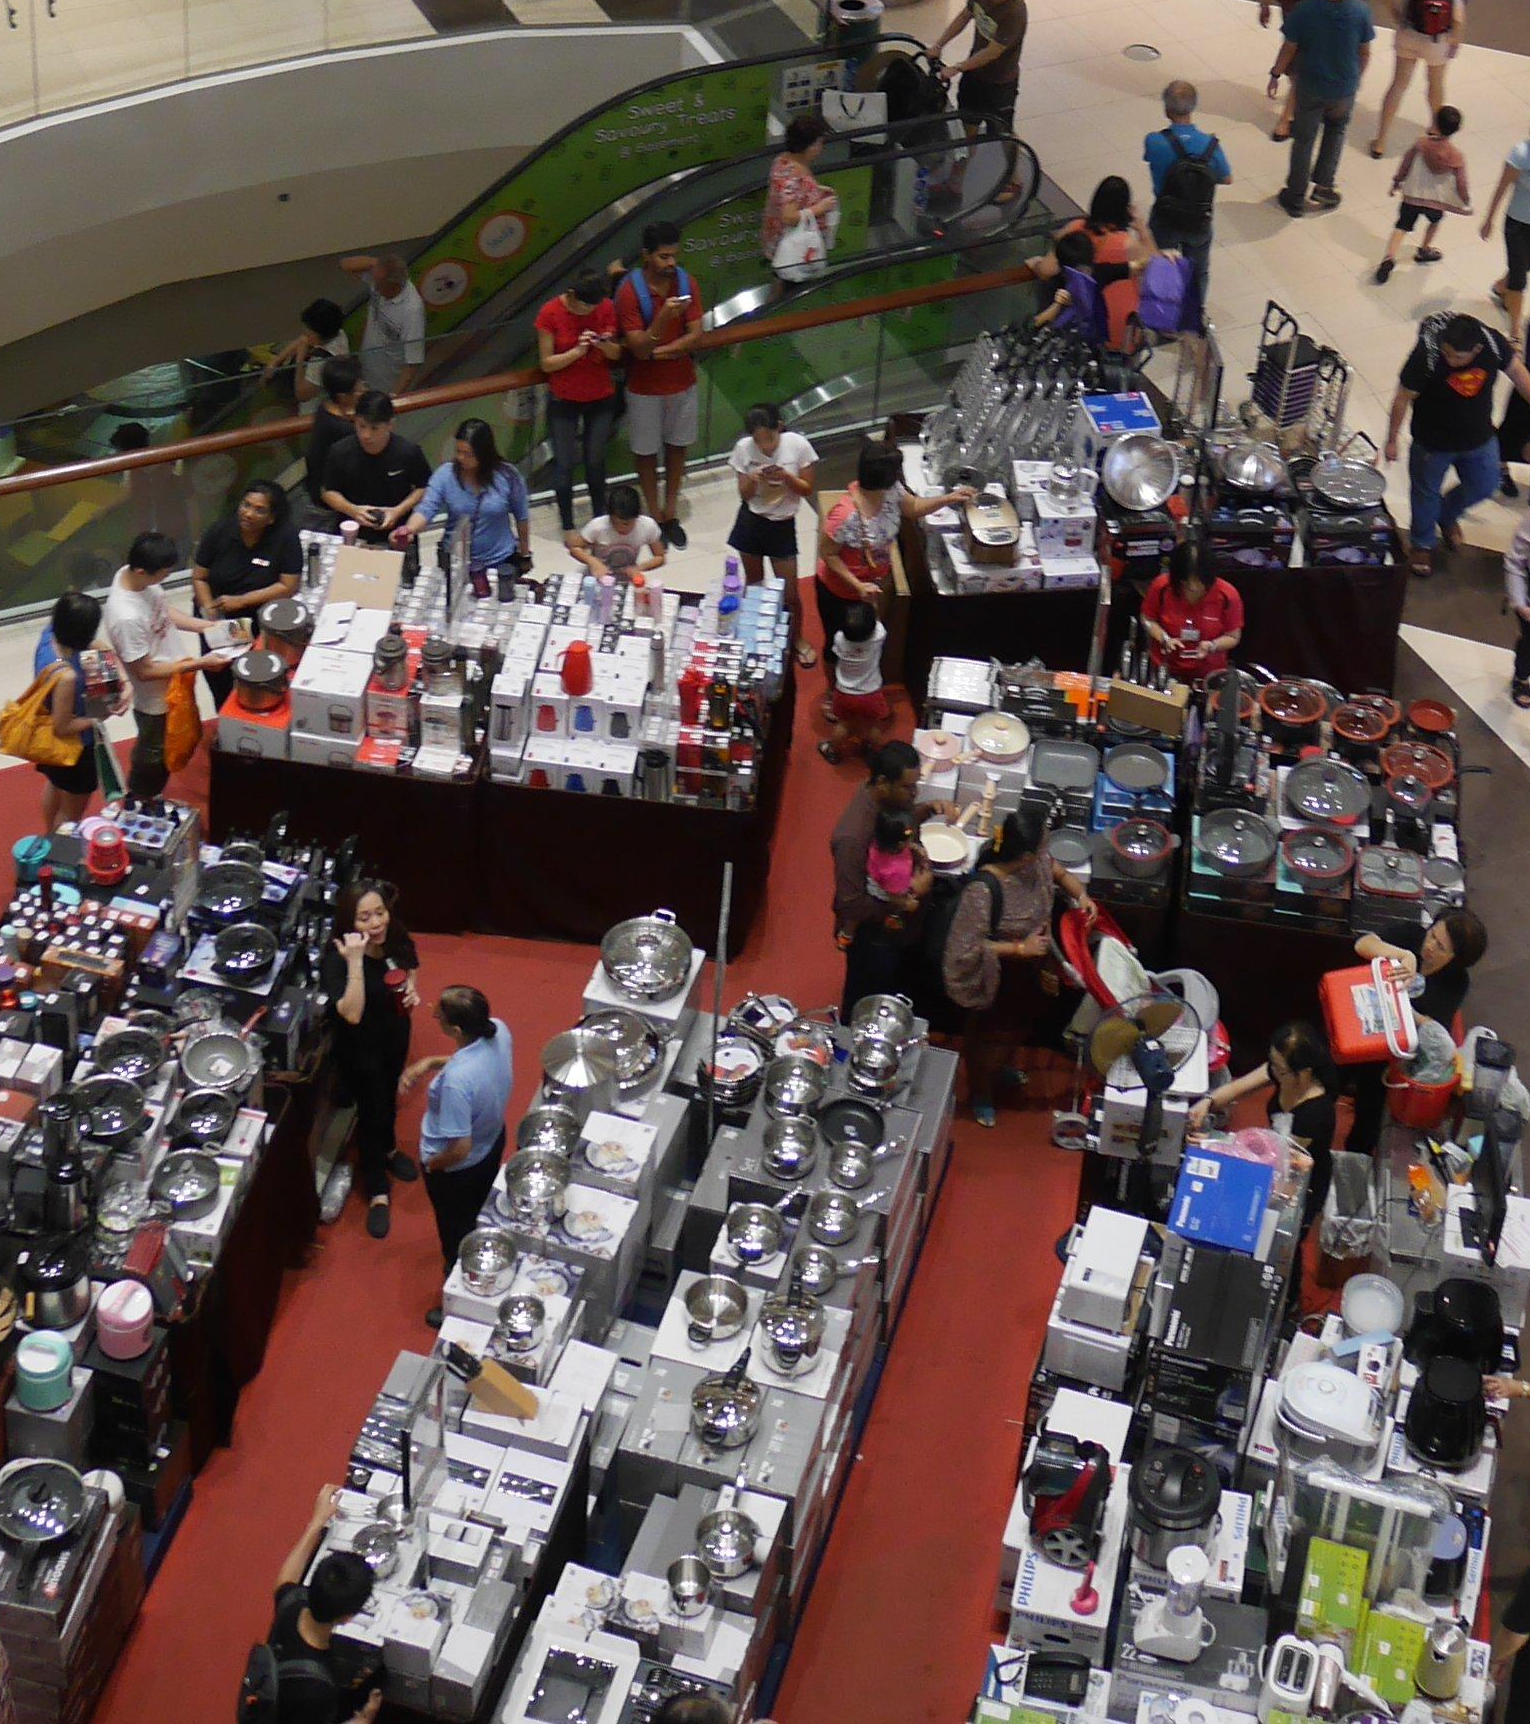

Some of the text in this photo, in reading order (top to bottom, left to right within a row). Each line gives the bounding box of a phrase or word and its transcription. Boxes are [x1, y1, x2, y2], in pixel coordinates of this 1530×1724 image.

[626, 97, 685, 120] Sweet
[678, 106, 737, 127] Treats
[1233, 1495, 1248, 1542] PHILIPS
[1017, 1551, 1039, 1607] PHILIPS
[1015, 1610, 1069, 1628] PHILIPS
